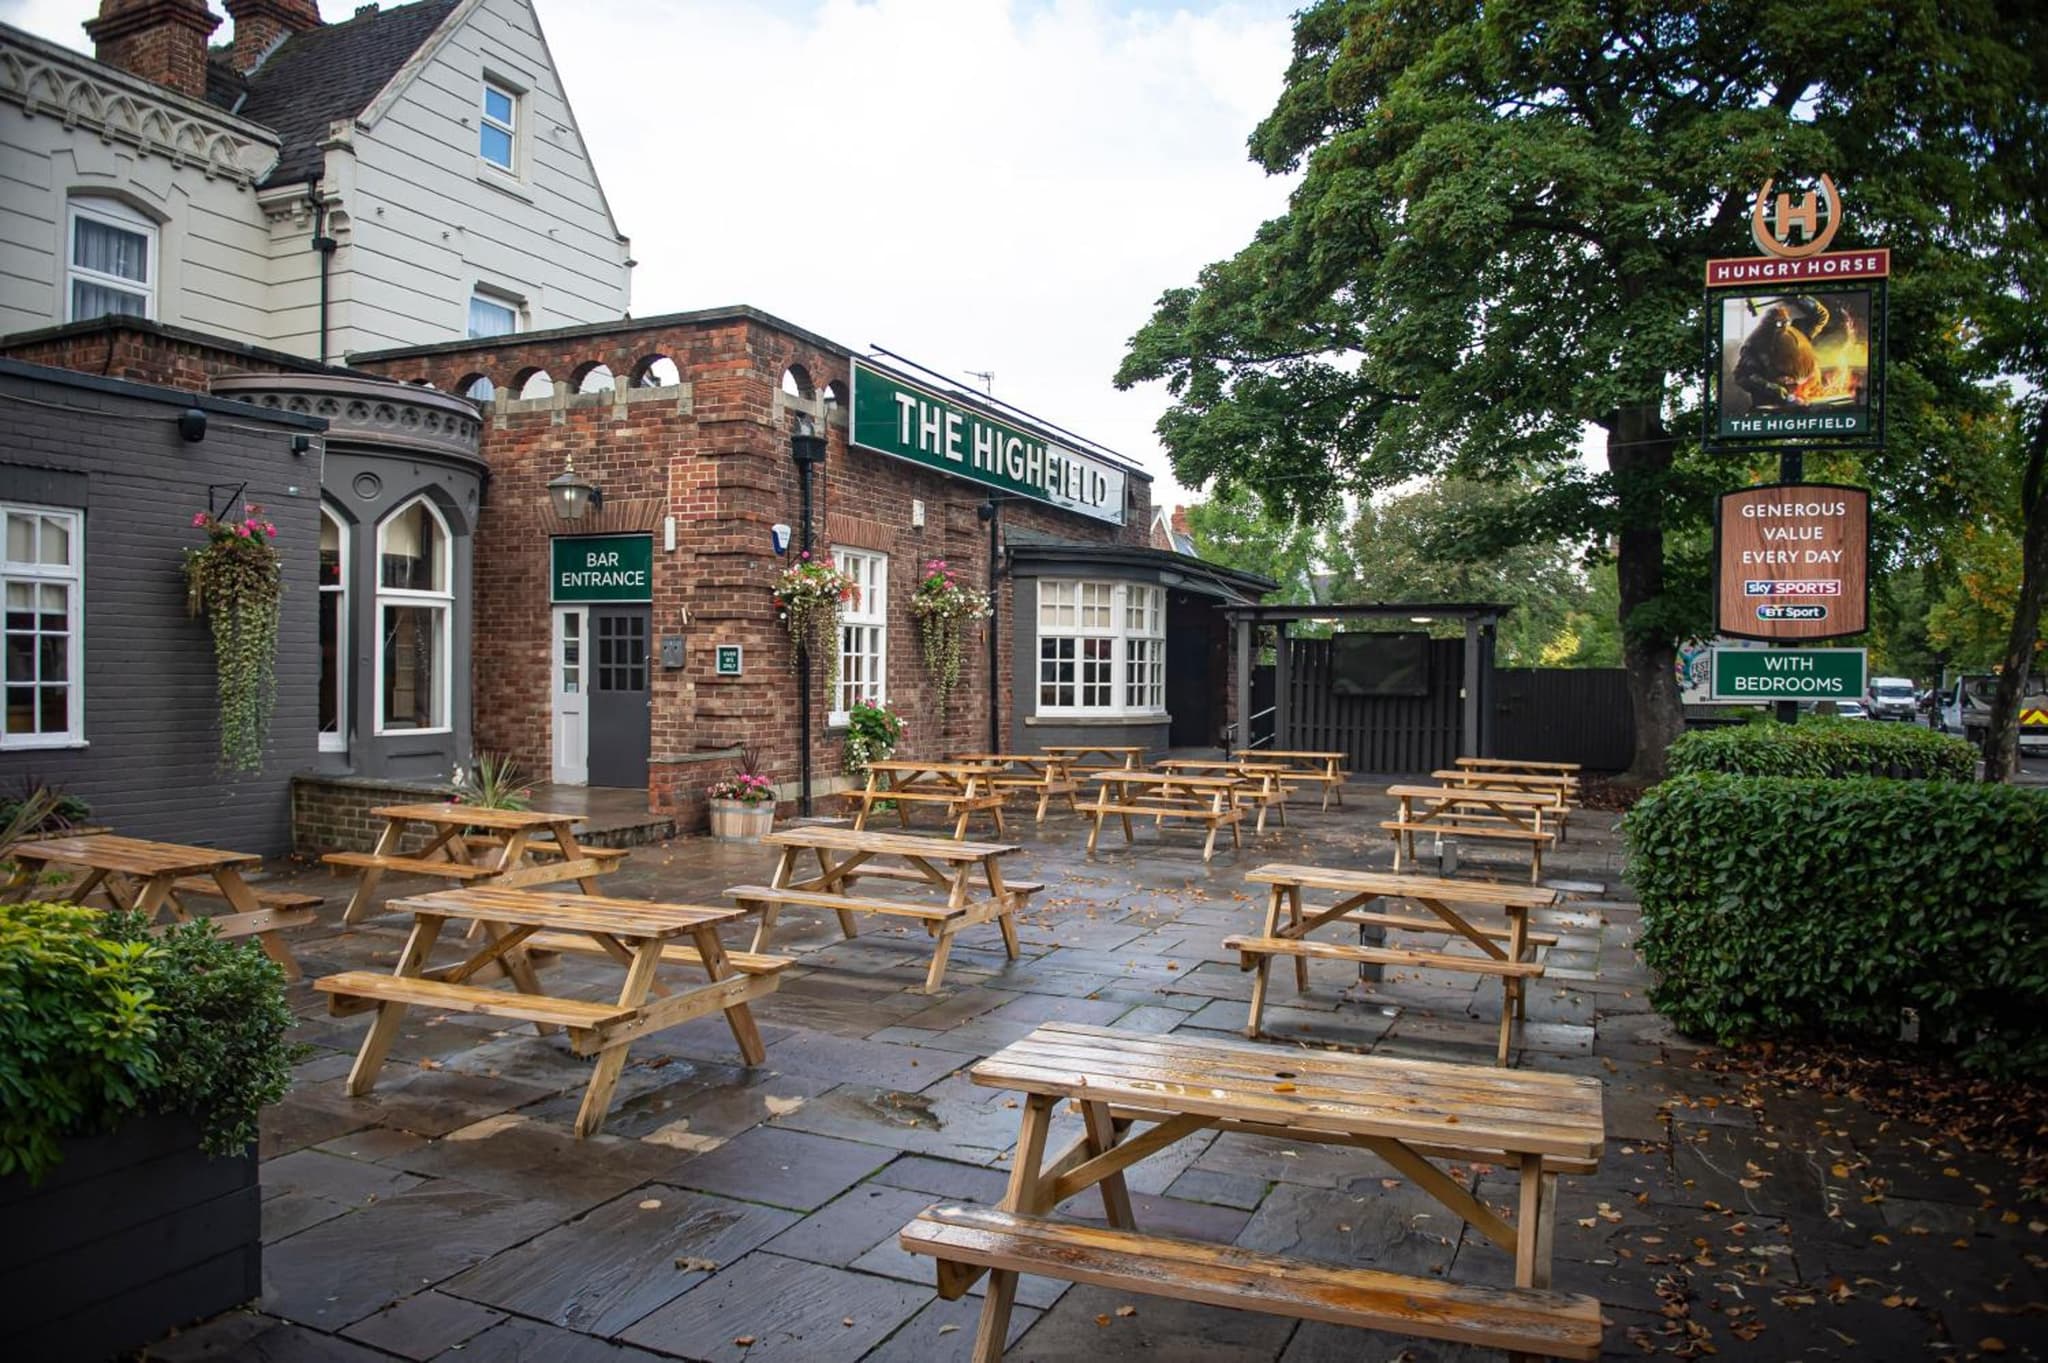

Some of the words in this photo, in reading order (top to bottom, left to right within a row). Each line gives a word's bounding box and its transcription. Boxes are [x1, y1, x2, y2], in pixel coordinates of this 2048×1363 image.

[1775, 191, 1816, 240] H
[1717, 262, 1801, 280] HUNGRY
[1807, 257, 1877, 274] HORSE
[1731, 420, 1761, 432] THE
[1767, 417, 1857, 431] HIGHFIELD
[895, 391, 964, 463] THE
[973, 422, 1109, 508] HIGHFIELD
[1742, 502, 1846, 518] GENEROUS
[1763, 526, 1824, 540] VALUE
[586, 551, 619, 567] BAR
[1743, 550, 1800, 565] EVERY
[1804, 549, 1843, 564] DAY
[561, 570, 645, 588] ENTRANCE
[1748, 581, 1771, 594] sky
[1775, 582, 1837, 594] SPORTS
[1765, 607, 1784, 617] BT
[1785, 607, 1820, 618] Sport
[1764, 656, 1814, 671] WITH
[1735, 676, 1843, 692] BEDROOMS
